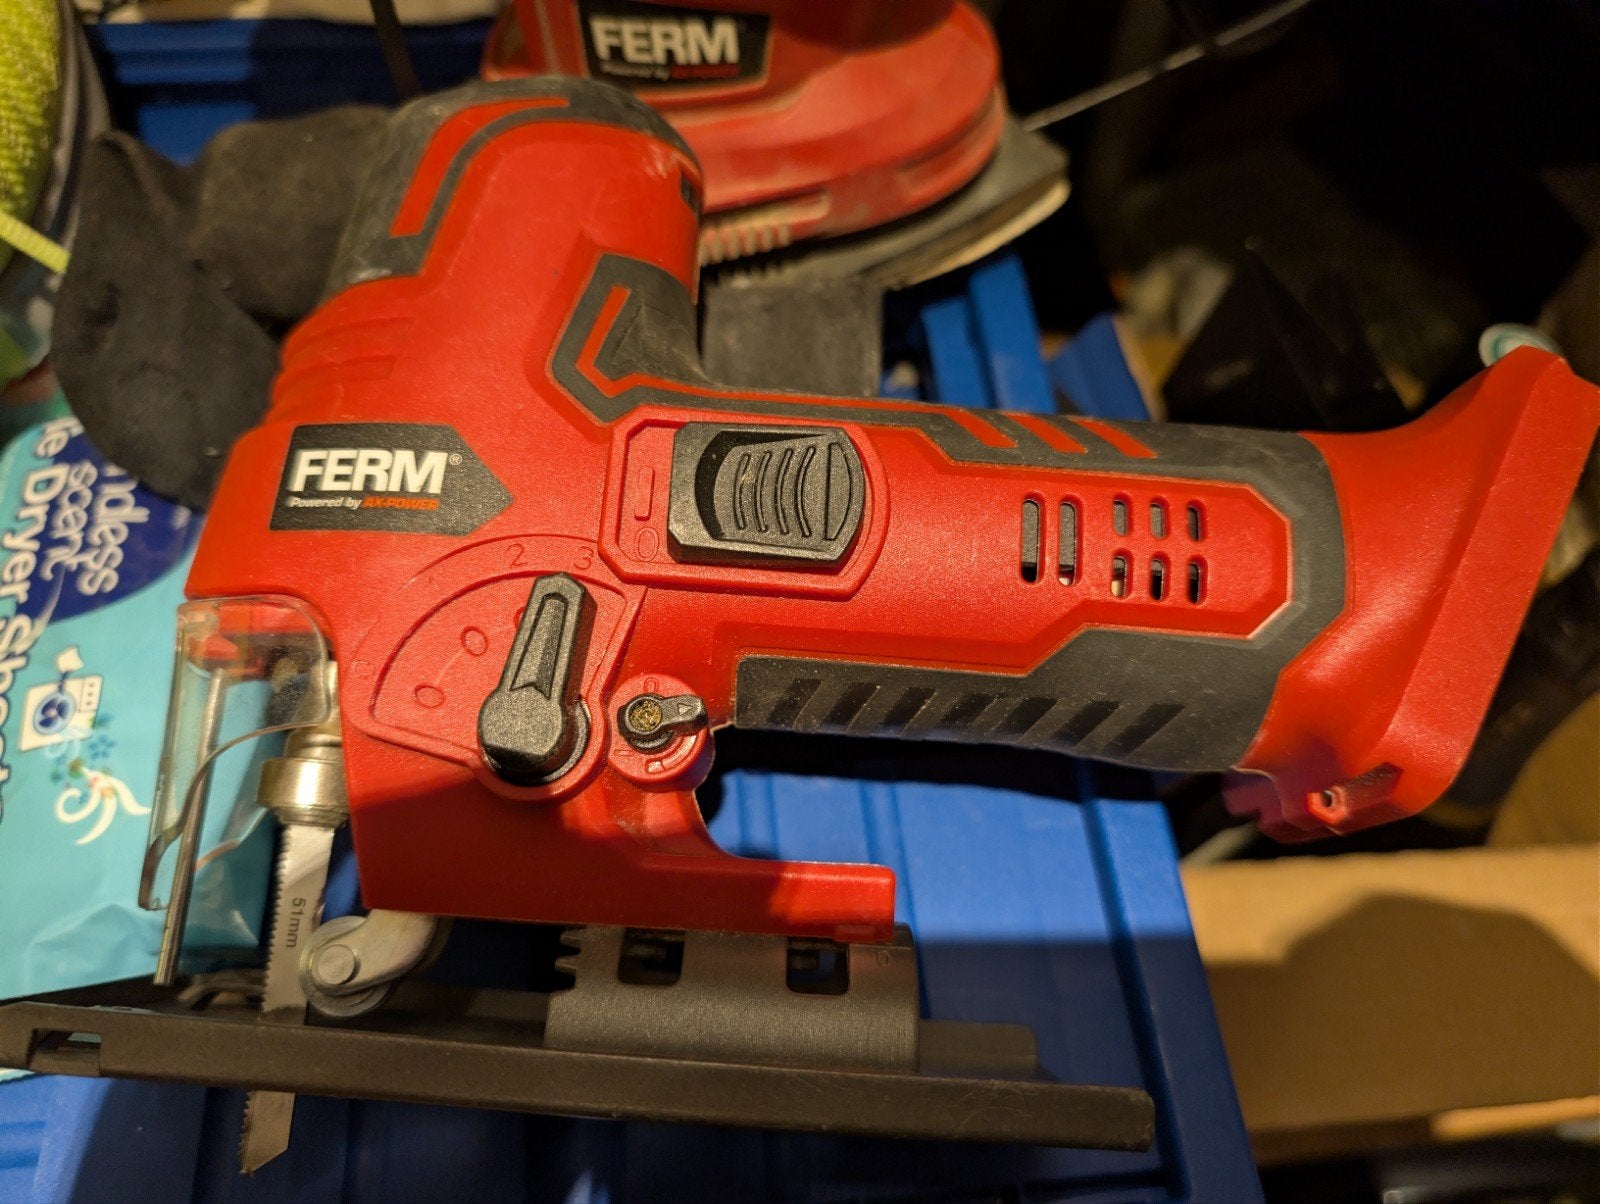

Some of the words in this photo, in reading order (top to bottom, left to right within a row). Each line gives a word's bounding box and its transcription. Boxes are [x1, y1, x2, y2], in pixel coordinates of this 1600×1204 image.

[590, 16, 740, 66] FERM
[40, 459, 98, 581] scent
[286, 496, 344, 509] Powered
[346, 497, 362, 511] by
[0, 463, 70, 603] Dryer
[506, 543, 528, 568] 2
[573, 545, 595, 570] 3
[286, 897, 307, 948] 51mm
